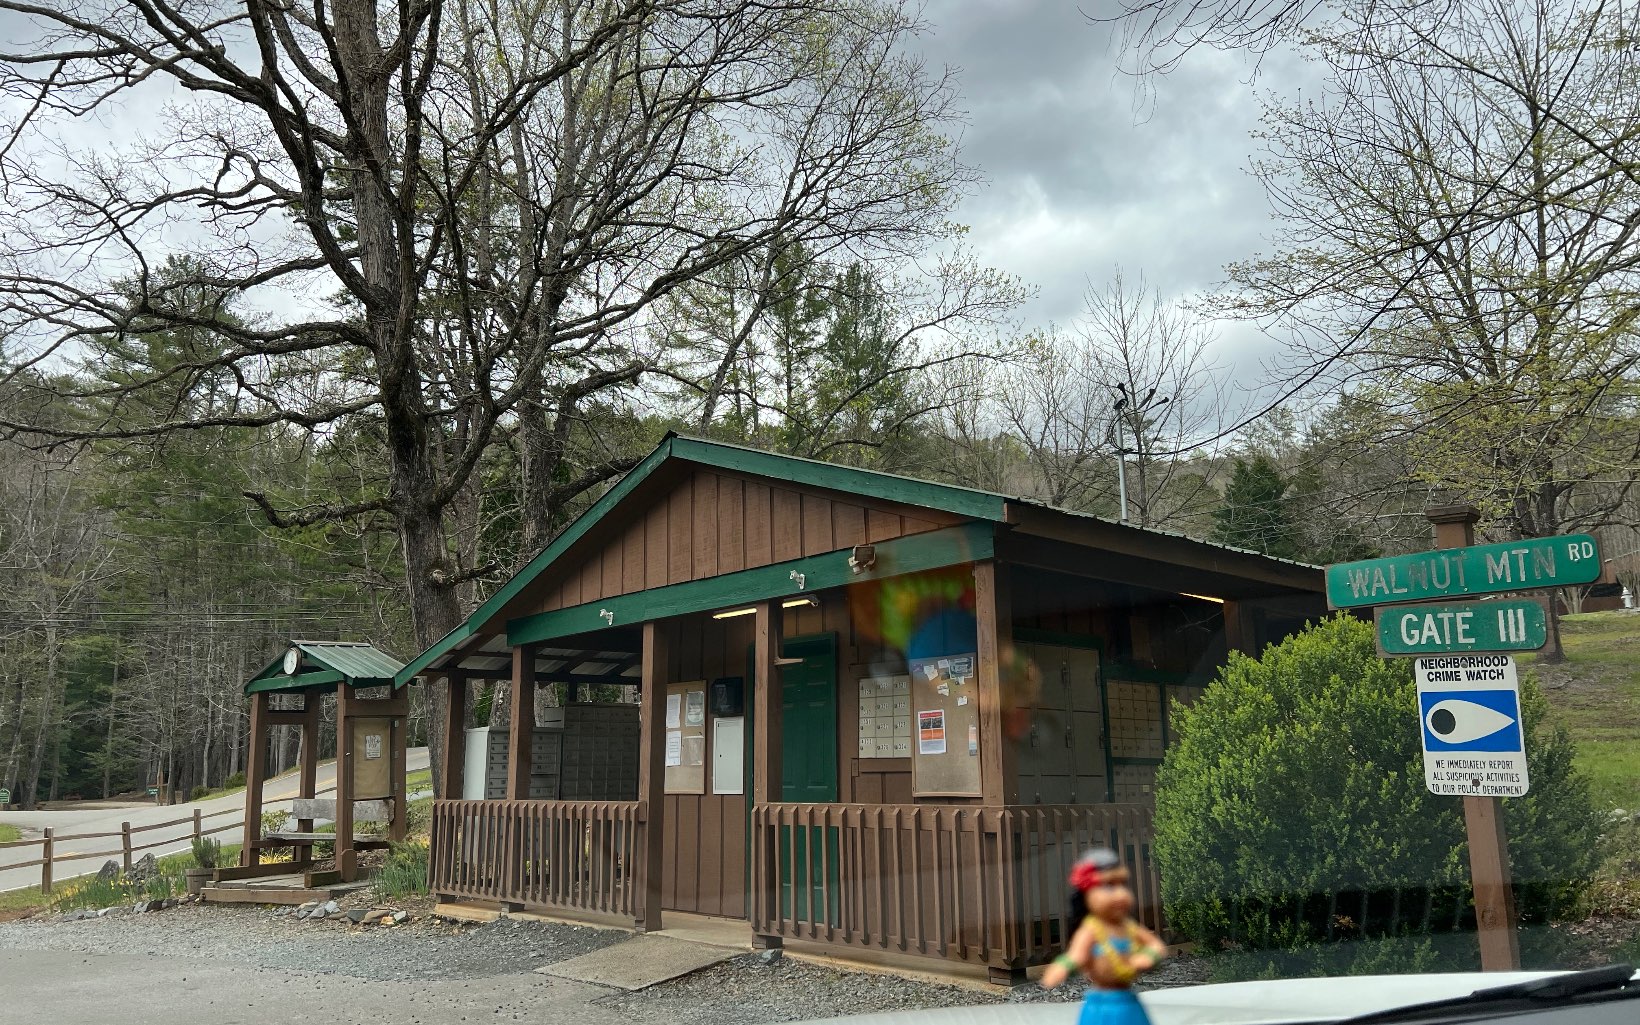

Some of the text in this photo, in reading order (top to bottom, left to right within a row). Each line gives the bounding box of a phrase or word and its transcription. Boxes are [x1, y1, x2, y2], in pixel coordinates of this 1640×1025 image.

[1348, 541, 1594, 598] WALNUT MTN RD
[1401, 608, 1526, 646] GATE III
[1420, 656, 1509, 670] NEIGHBORHOOD
[1427, 669, 1504, 682] CRIME WATCH
[1435, 759, 1514, 770] WE IMMEDIATELY REPORT
[1432, 771, 1520, 783] ALL SUSPICIOUS ACTIVITIES
[1431, 783, 1523, 795] TO OUR POLICE DEPARTMENT
